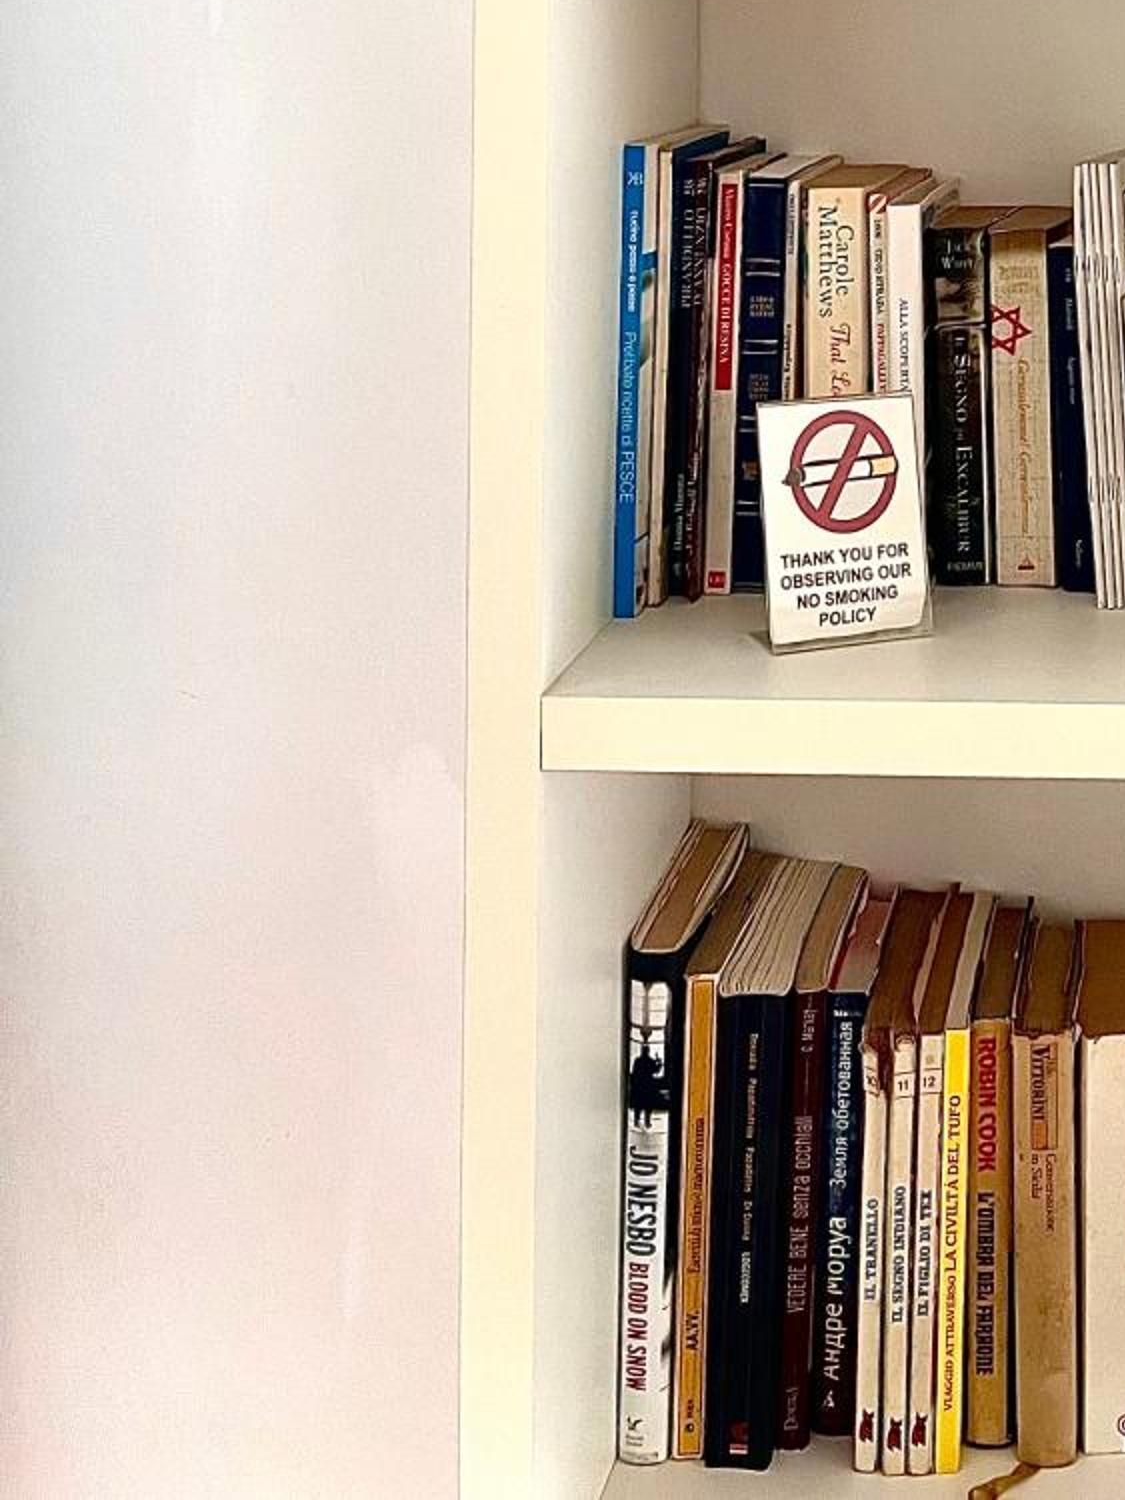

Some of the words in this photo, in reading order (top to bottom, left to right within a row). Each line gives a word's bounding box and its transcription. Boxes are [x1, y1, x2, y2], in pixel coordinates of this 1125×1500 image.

[721, 263, 731, 304] GOCCE
[835, 225, 855, 296] Carole
[818, 206, 838, 318] Matthews
[830, 323, 851, 365] That
[721, 308, 731, 319] DI
[899, 299, 908, 328] ALLA
[719, 321, 729, 363] RESINA
[899, 332, 909, 392] SCOPERTA
[953, 354, 972, 423] SEGNO
[619, 451, 634, 503] PESCE
[955, 445, 974, 553] EXCALIBUR
[780, 550, 835, 569] THANK
[838, 546, 873, 562] YOU
[877, 543, 909, 559] FOR
[781, 566, 873, 590] OBSERVING
[878, 562, 912, 579] OUR
[797, 593, 820, 609] NO
[825, 584, 898, 607] SMOKING
[820, 607, 877, 626] POLICY
[834, 1021, 854, 1131] обетованная
[897, 1079, 910, 1092] 11
[921, 1074, 936, 1089] 12
[978, 1036, 996, 1107] ROBIN
[1031, 1046, 1051, 1120] VITTORINI
[947, 1095, 962, 1138] TUFO
[629, 1146, 659, 1176] JO
[792, 1115, 813, 1170] occhiali
[829, 1136, 849, 1189] Земля
[946, 1144, 960, 1175] DEL
[978, 1113, 996, 1172] COOK
[626, 1182, 657, 1256] NESBO
[793, 1175, 810, 1219] senza
[893, 1186, 905, 1251] INDIANO
[920, 1190, 931, 1220] TEX
[789, 1224, 808, 1259] BENE
[866, 1198, 879, 1279] TRANELLO
[920, 1226, 930, 1242] DI
[977, 1192, 994, 1265] L'OMBRA
[893, 1255, 904, 1303] SEGNO
[918, 1246, 930, 1296] FIGLIO
[944, 1249, 957, 1272] LA
[627, 1261, 649, 1314] BLOOD
[787, 1264, 807, 1313] VEDERE
[865, 1283, 878, 1300] IL
[917, 1300, 928, 1316] IL
[975, 1272, 994, 1300] DEL
[627, 1318, 648, 1340] ON
[892, 1308, 903, 1323] IL
[945, 1275, 957, 1356] ATTRAVERSO
[975, 1305, 994, 1376] FARAONE
[625, 1345, 647, 1392] SNOW
[942, 1359, 955, 1411] VIAGGIO
